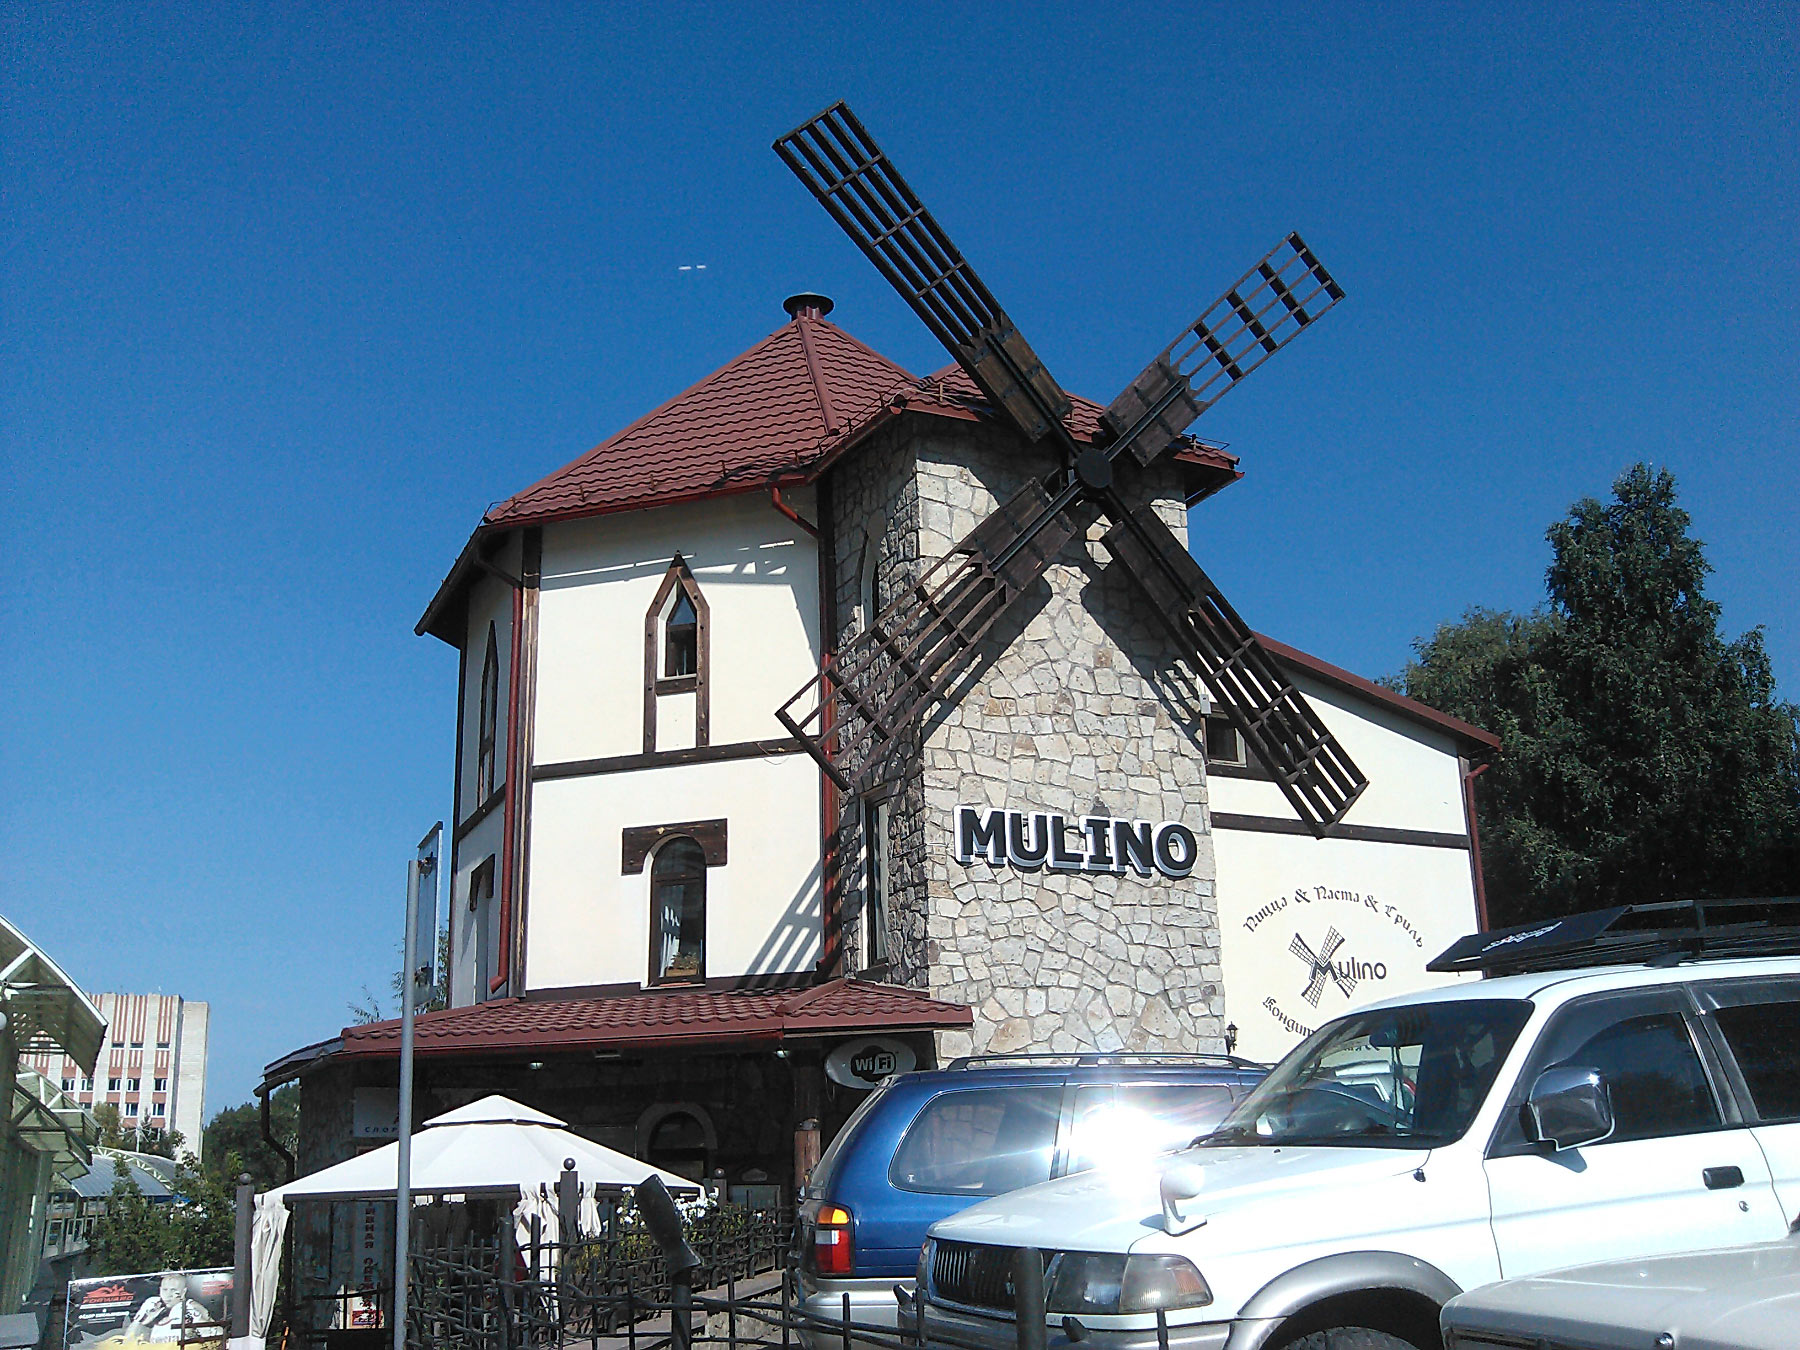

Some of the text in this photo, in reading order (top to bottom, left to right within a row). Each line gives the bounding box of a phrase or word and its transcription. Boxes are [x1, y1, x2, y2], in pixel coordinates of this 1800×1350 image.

[954, 805, 1198, 877] MULINO
[1243, 885, 1423, 948] Пицца & Паста & Гриль
[1311, 957, 1387, 981] Mulino
